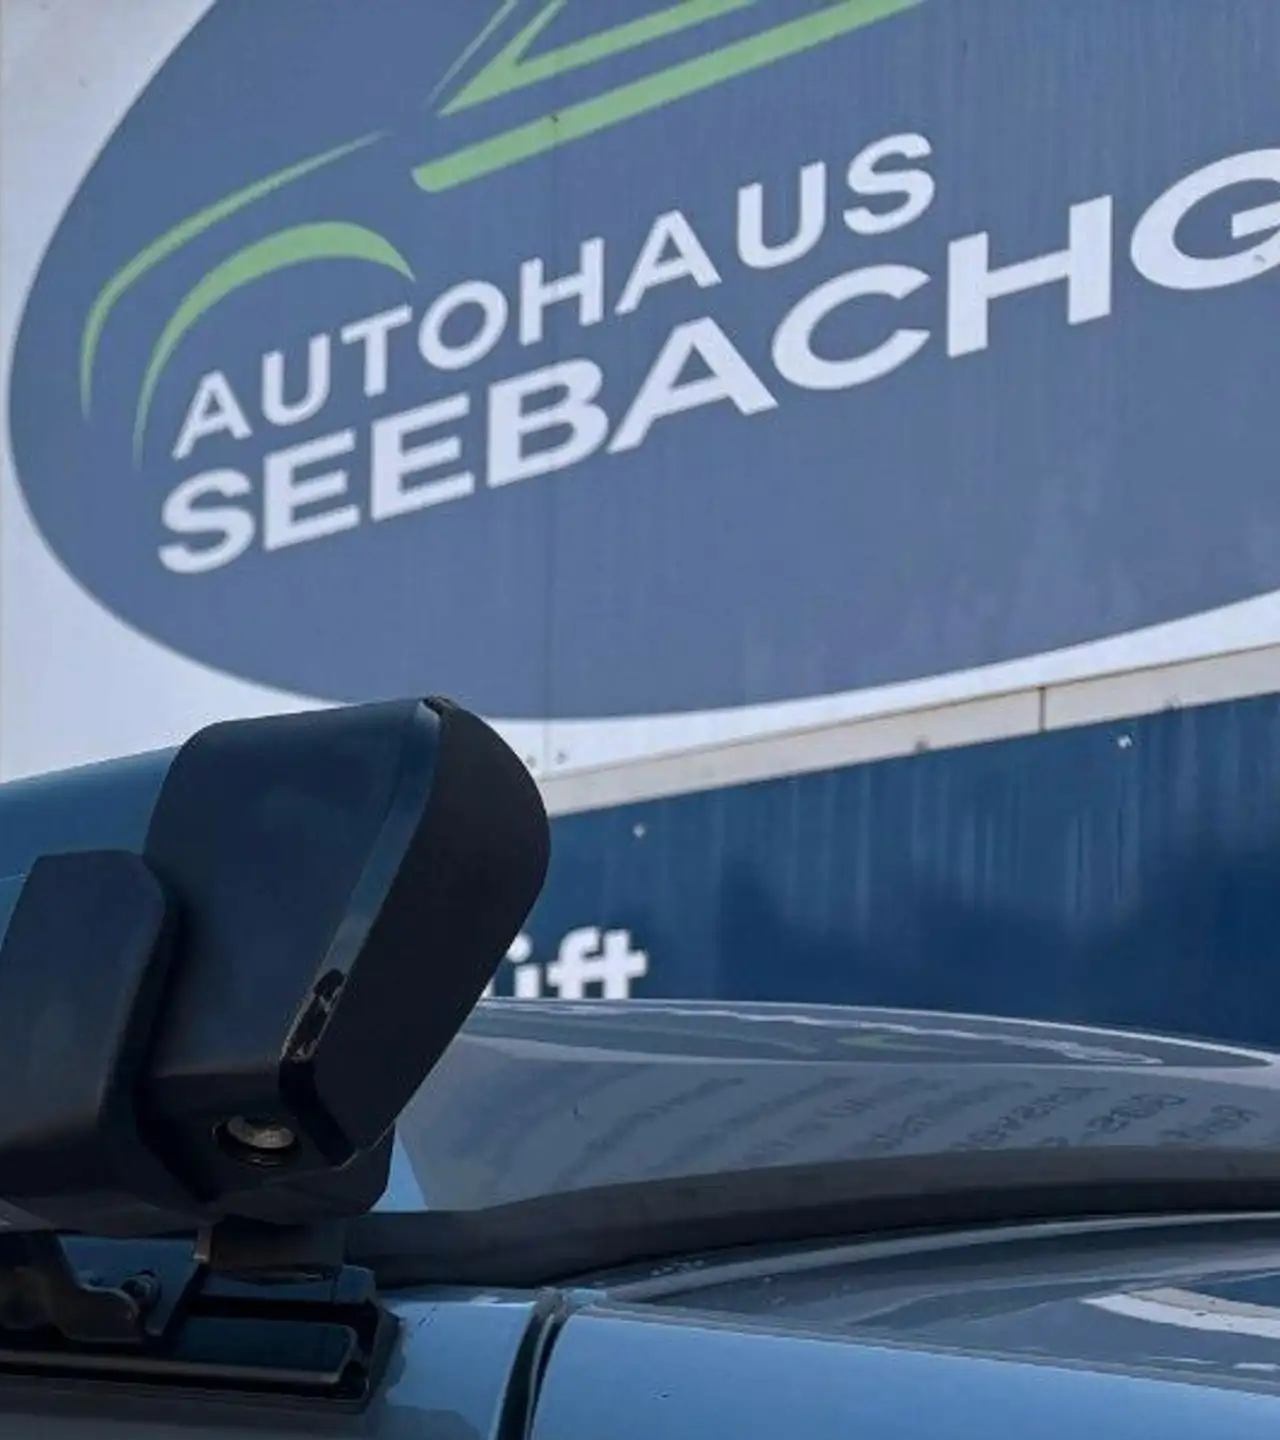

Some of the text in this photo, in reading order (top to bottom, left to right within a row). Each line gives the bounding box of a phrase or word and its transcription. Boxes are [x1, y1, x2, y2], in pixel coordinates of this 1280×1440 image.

[158, 148, 1280, 574] SEEBACHG
[171, 132, 936, 460] AUTOHAUS
[482, 926, 648, 1000] ift
